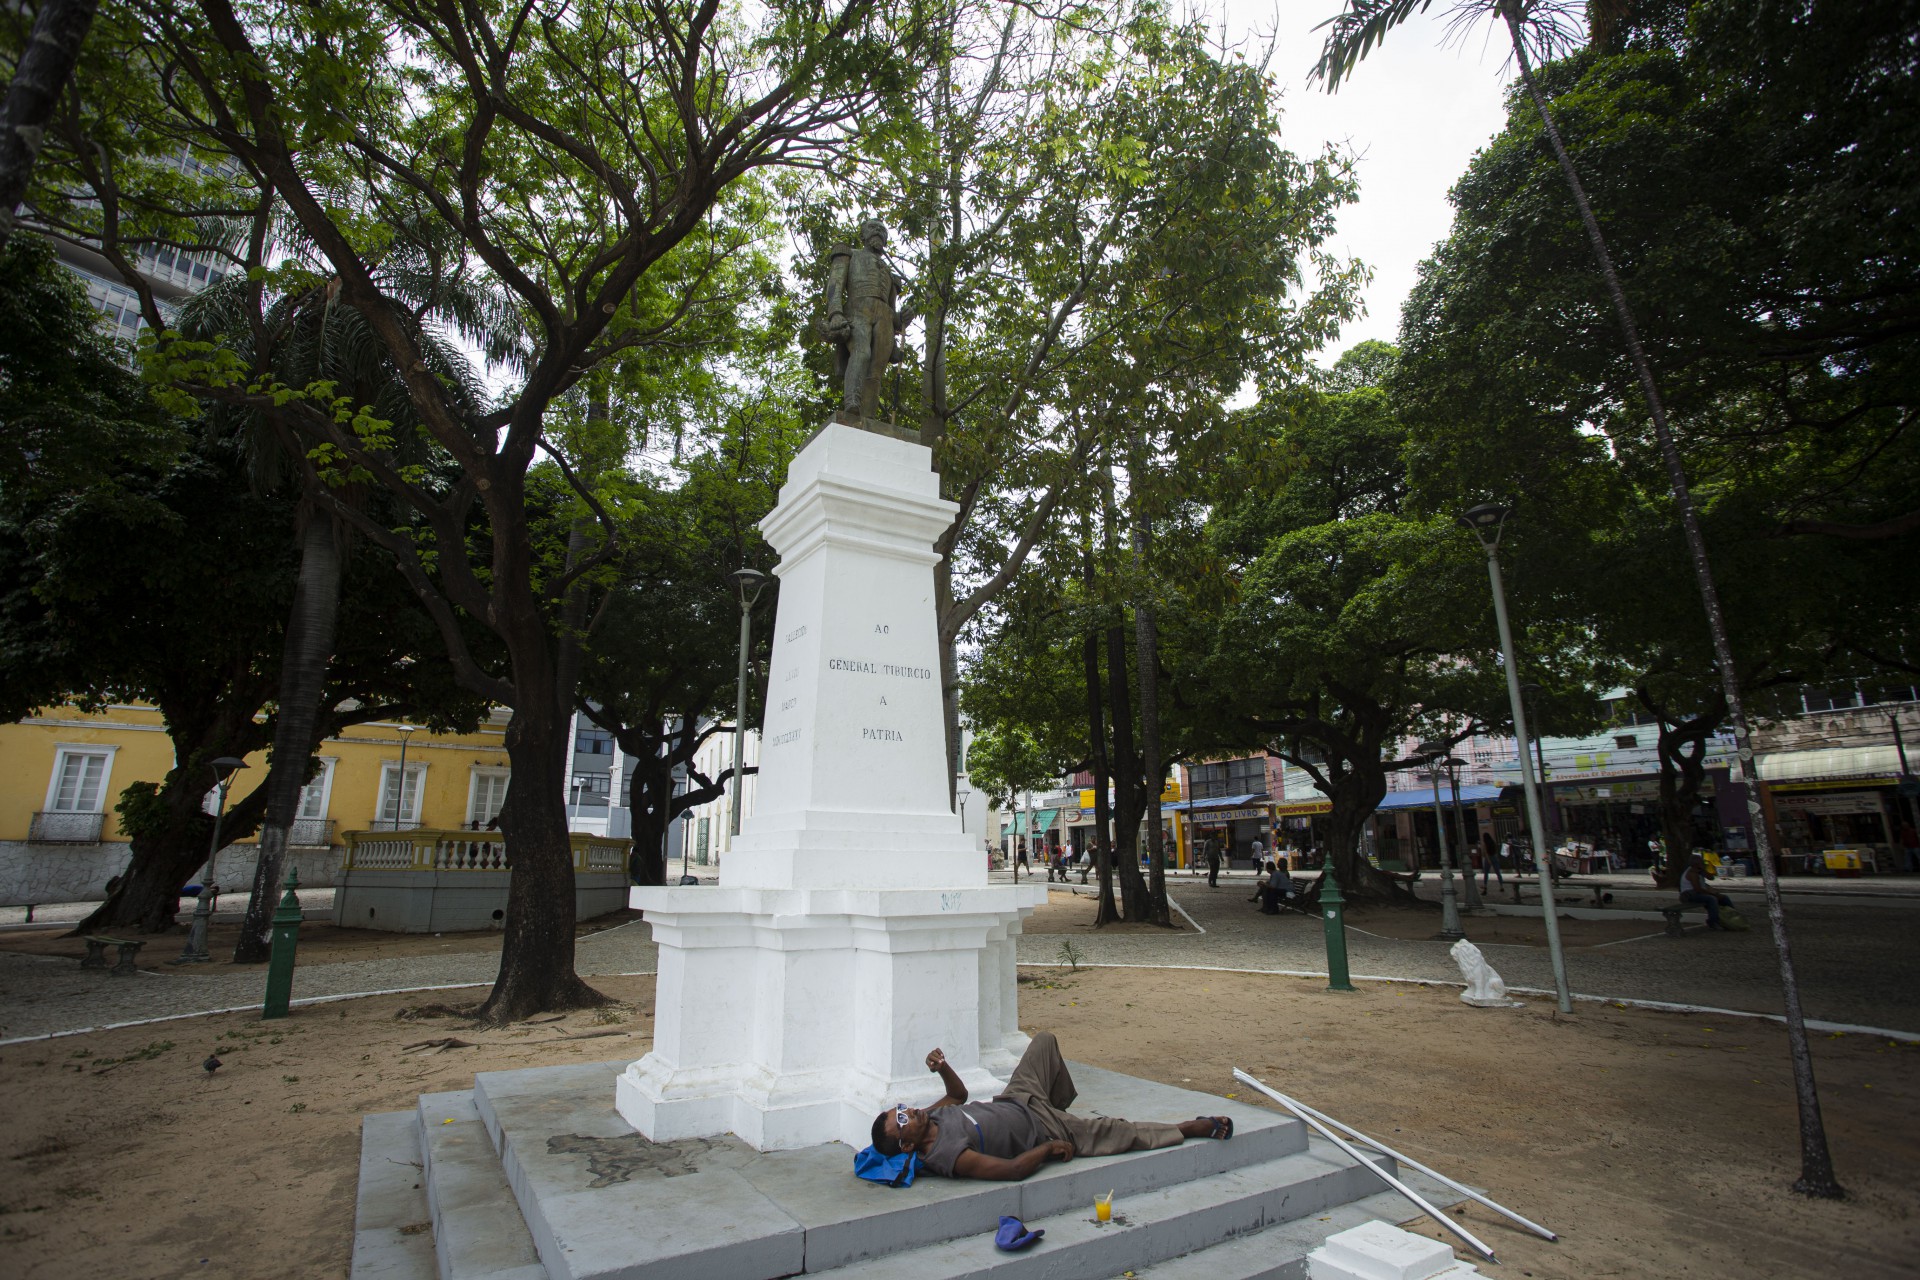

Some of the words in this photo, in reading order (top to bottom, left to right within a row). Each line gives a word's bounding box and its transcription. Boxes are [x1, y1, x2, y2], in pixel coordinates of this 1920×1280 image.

[875, 624, 890, 634] AO
[829, 659, 877, 674] GENERAL
[883, 664, 931, 680] TIBURCIO
[879, 695, 888, 706] A
[863, 728, 904, 742] PATRIA
[1600, 767, 1643, 778] Papelaria
[1278, 805, 1317, 814] SHOPPING
[1188, 812, 1219, 822] ALERIA
[1220, 812, 1232, 820] DO
[1234, 809, 1259, 819] LIVRO
